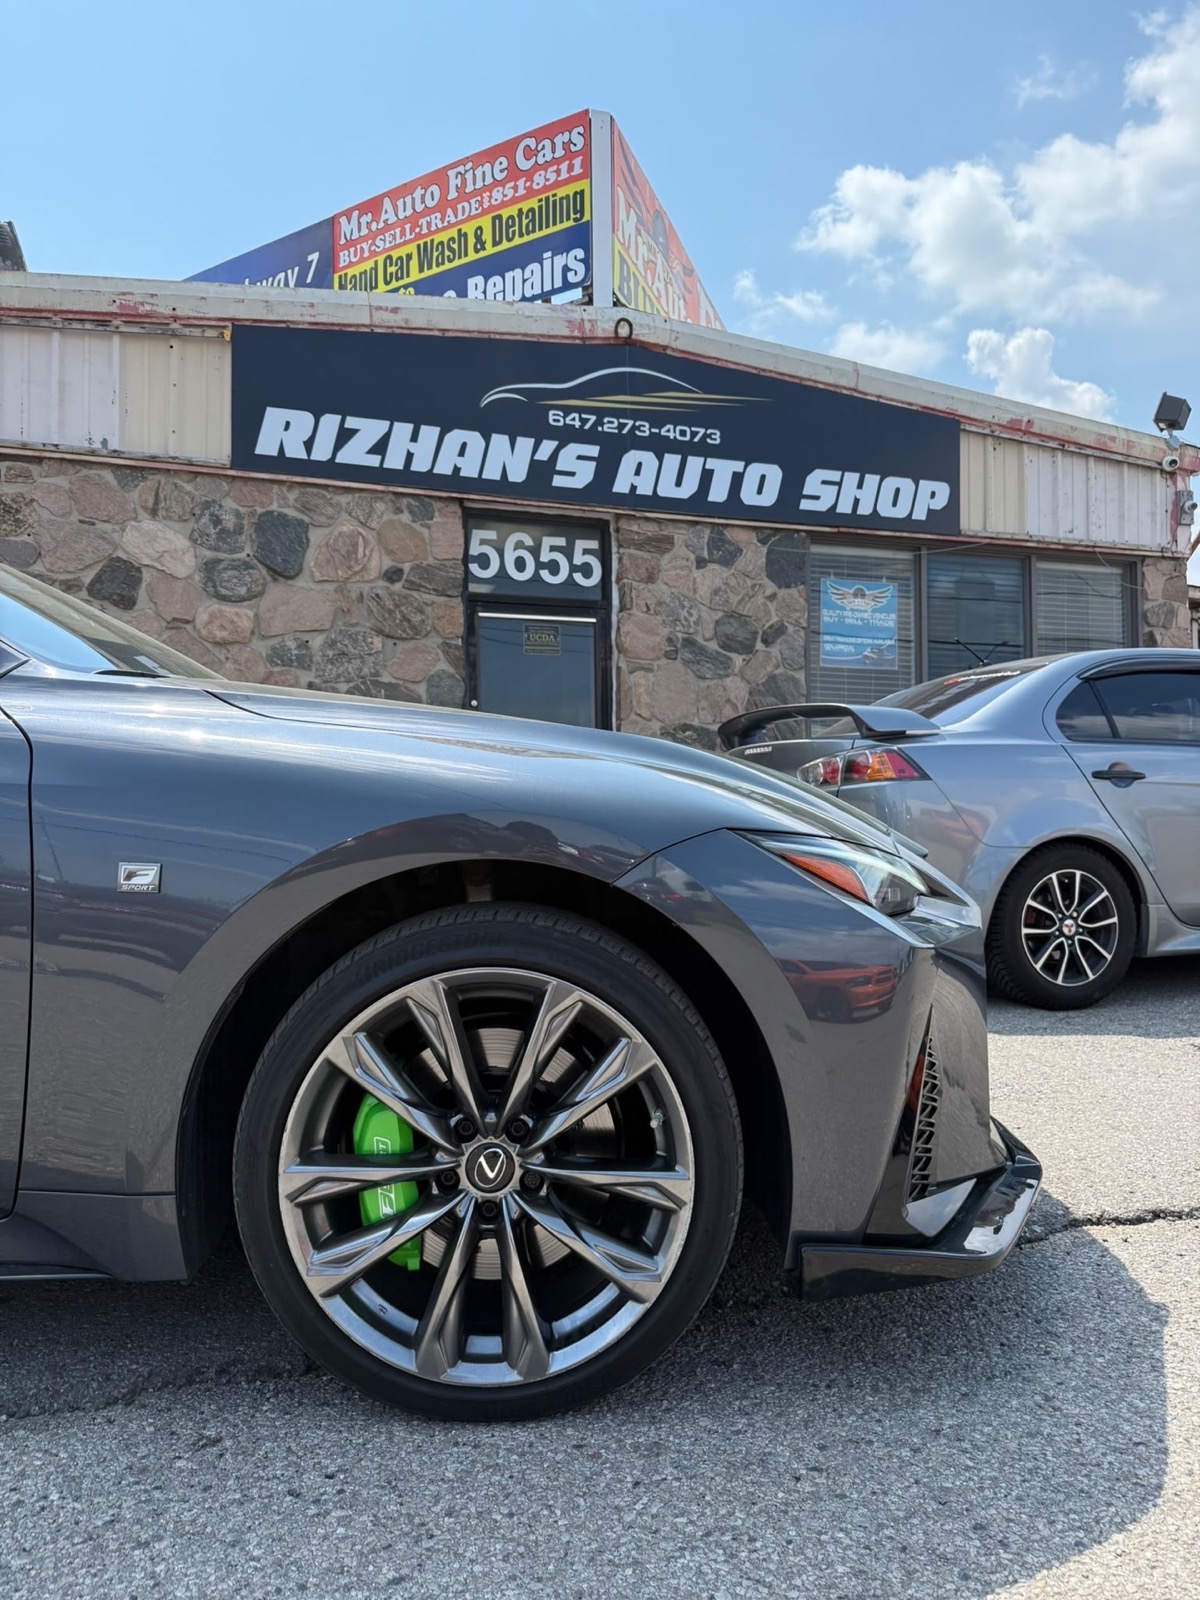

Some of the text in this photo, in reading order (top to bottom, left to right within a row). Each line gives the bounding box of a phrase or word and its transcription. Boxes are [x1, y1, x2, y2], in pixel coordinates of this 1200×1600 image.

[446, 161, 509, 200] Fine
[515, 125, 585, 171] Cars
[338, 190, 585, 292] Hand Car Wash & Detailing
[339, 196, 482, 268] BUY-SELL-TRADE
[491, 156, 583, 205] 851-8511
[306, 252, 320, 284] 7
[467, 248, 586, 301] Repairs
[547, 410, 721, 444] 647.273-4073
[254, 406, 950, 521] RIZHAN'S AUTO SHOP
[468, 529, 602, 587] 5655
[529, 633, 556, 642] UCDA
